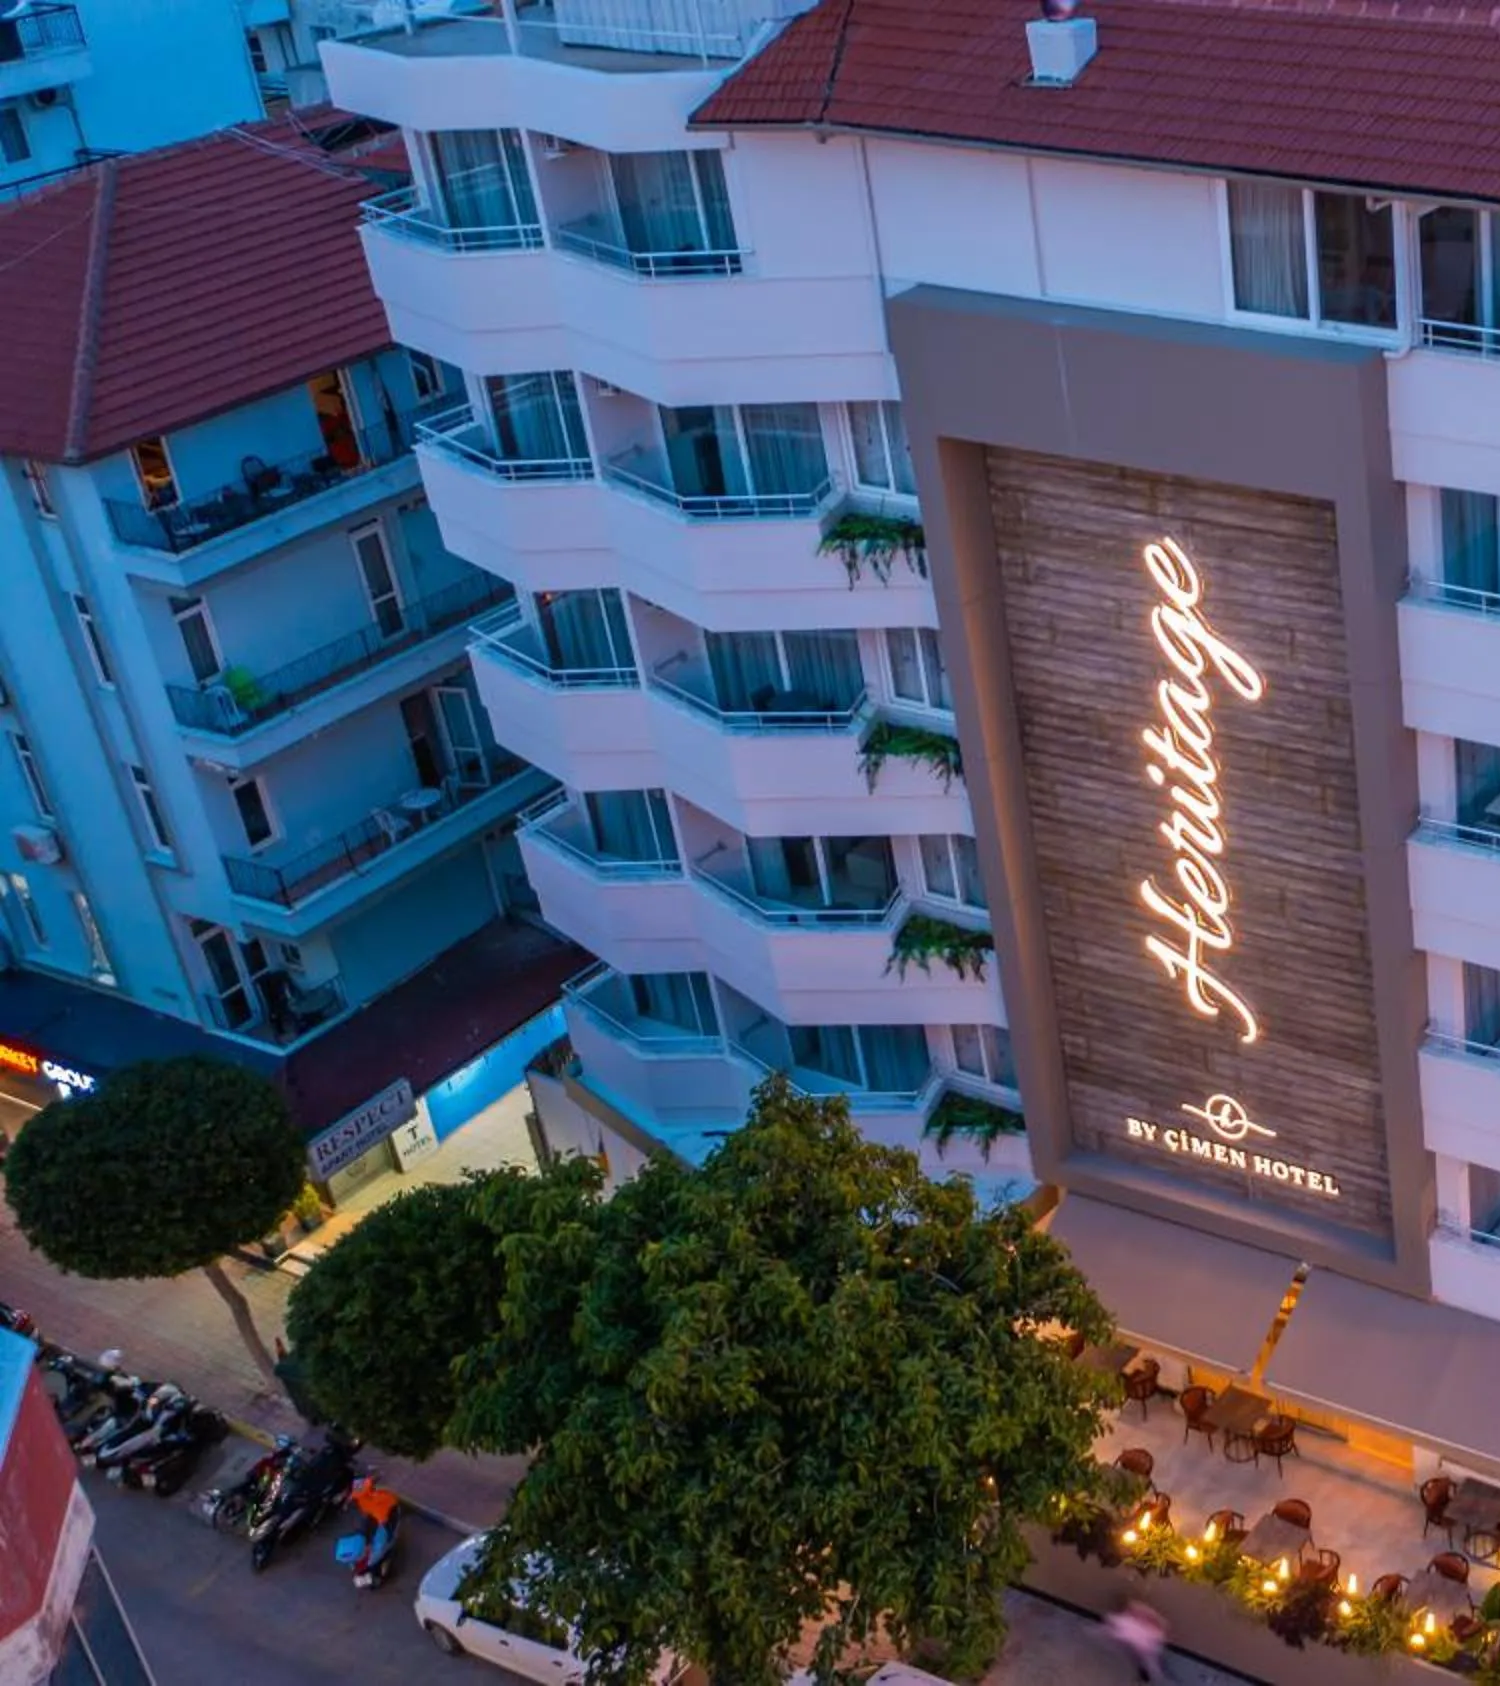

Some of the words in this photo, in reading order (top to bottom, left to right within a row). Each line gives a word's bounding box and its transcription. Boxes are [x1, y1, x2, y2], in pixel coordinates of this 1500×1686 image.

[1140, 536, 1264, 1044] Heritage
[315, 1088, 408, 1161] RESPECT
[1127, 1117, 1157, 1142] BY
[1163, 1129, 1247, 1170] ÇİMEN
[1252, 1155, 1340, 1196] HOTEL
